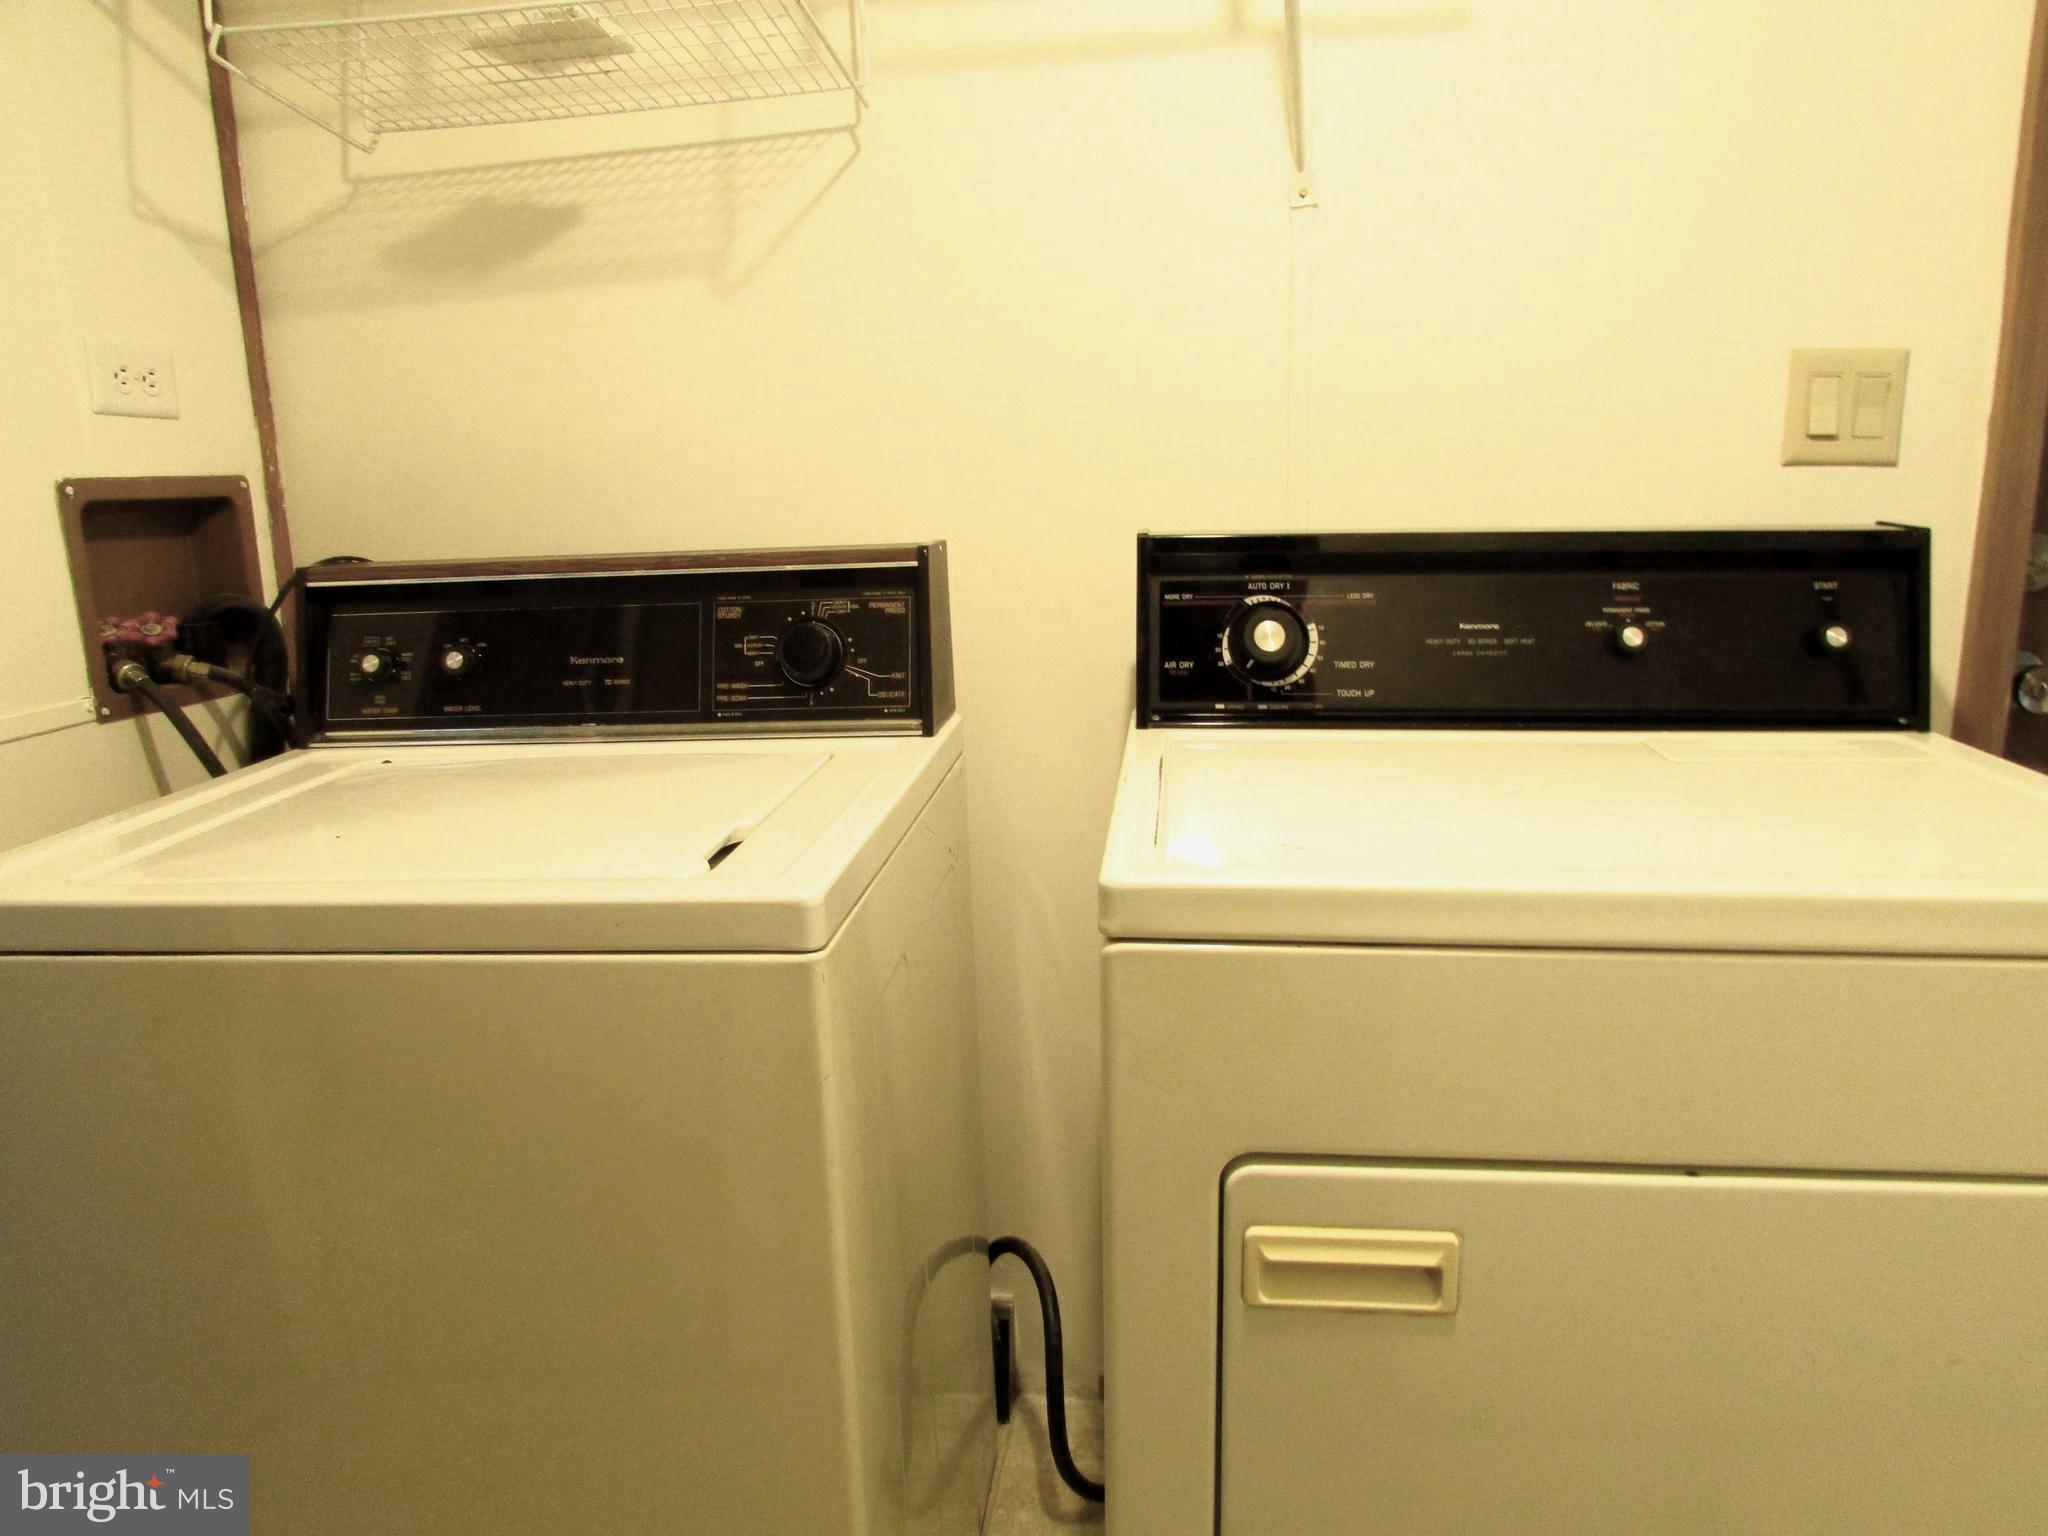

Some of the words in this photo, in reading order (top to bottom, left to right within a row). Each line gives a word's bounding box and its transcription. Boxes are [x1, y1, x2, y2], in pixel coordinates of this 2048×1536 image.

[1247, 582, 1267, 591] AUTO
[1269, 582, 1285, 591] DRY
[1459, 622, 1500, 630] Kenmore
[569, 655, 625, 665] Kenmore
[1164, 661, 1177, 669] AIR
[1179, 661, 1194, 669] DRY
[1334, 661, 1357, 669] TIMED
[1359, 661, 1375, 669] DRY
[1337, 690, 1362, 698] TOUCH
[1364, 690, 1375, 698] UP
